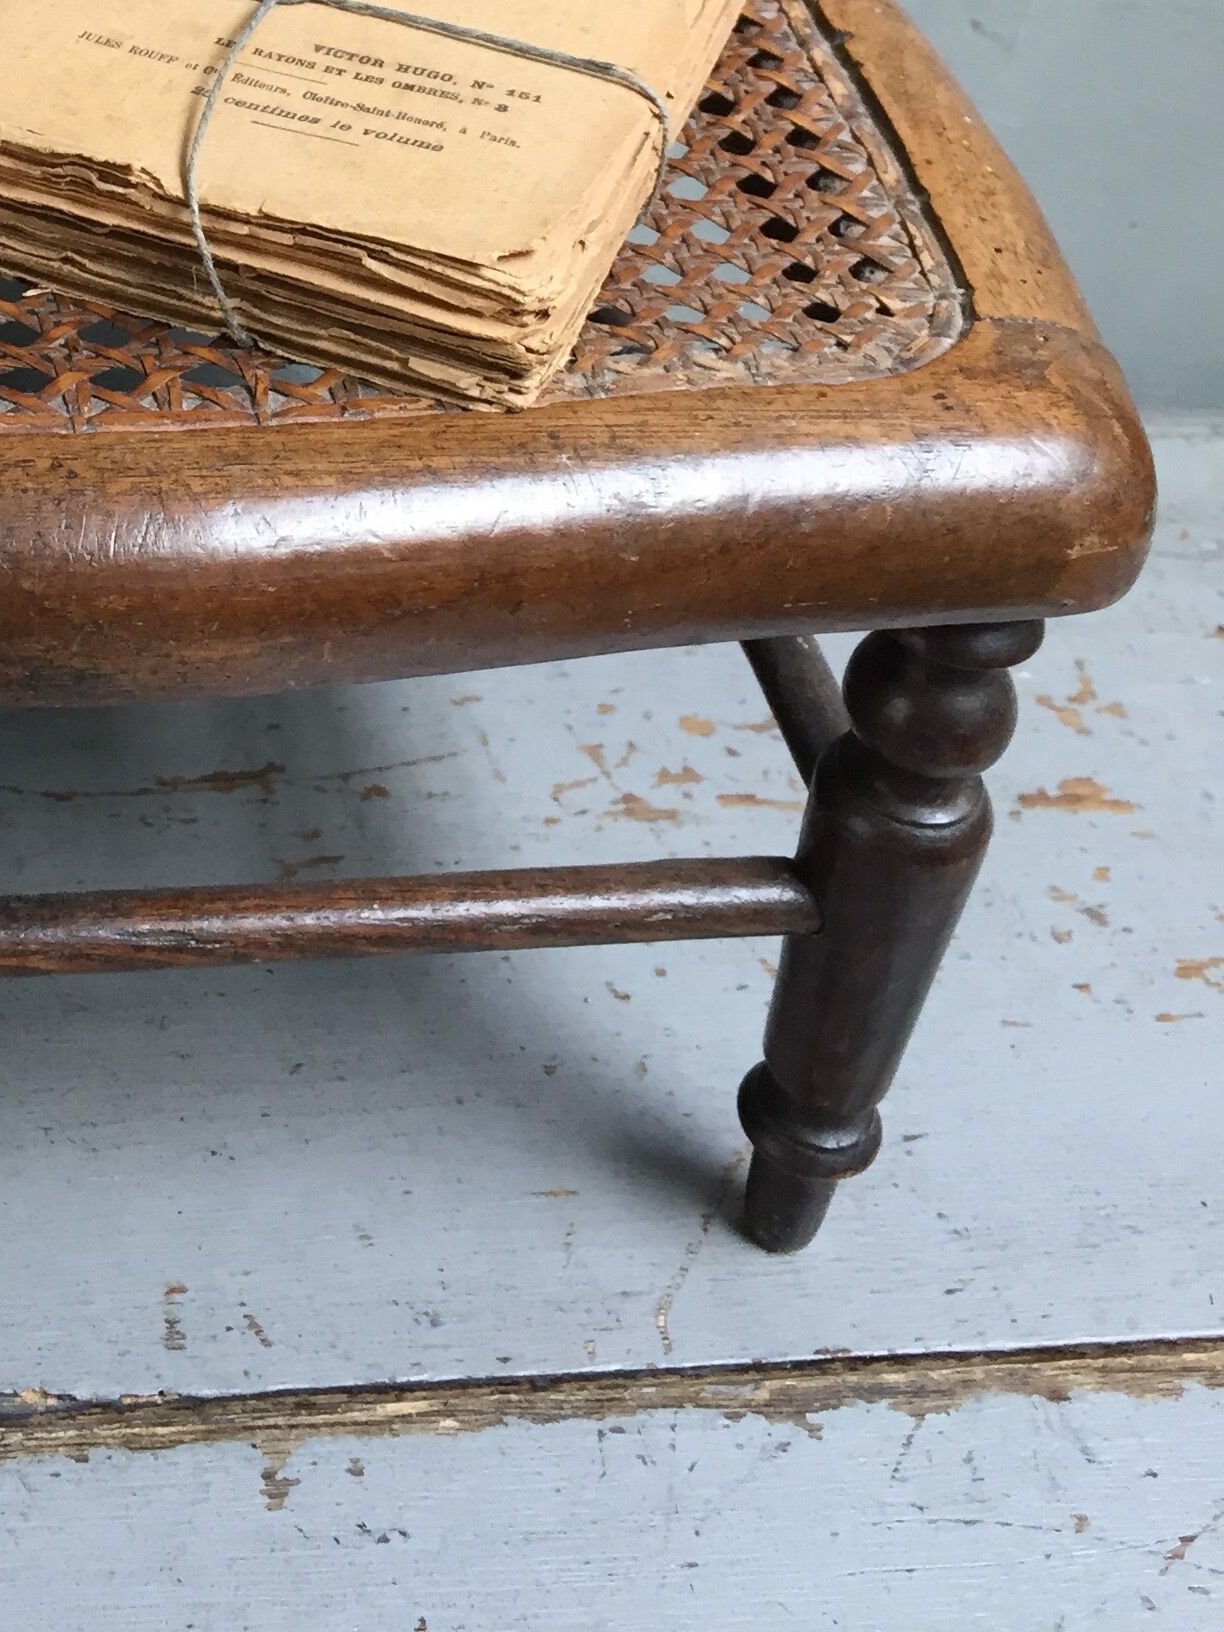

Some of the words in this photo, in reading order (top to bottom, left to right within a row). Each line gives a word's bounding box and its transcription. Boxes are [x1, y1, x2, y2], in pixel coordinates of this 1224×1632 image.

[77, 30, 124, 50] JULES
[127, 45, 179, 65] ROUFF
[214, 37, 239, 49] LE
[251, 47, 317, 70] RAYONS
[323, 65, 347, 77] ET
[353, 71, 385, 86] LES
[313, 44, 386, 68] VICTOR
[223, 96, 321, 126] centimes
[329, 120, 353, 132] le
[362, 127, 445, 153] volume
